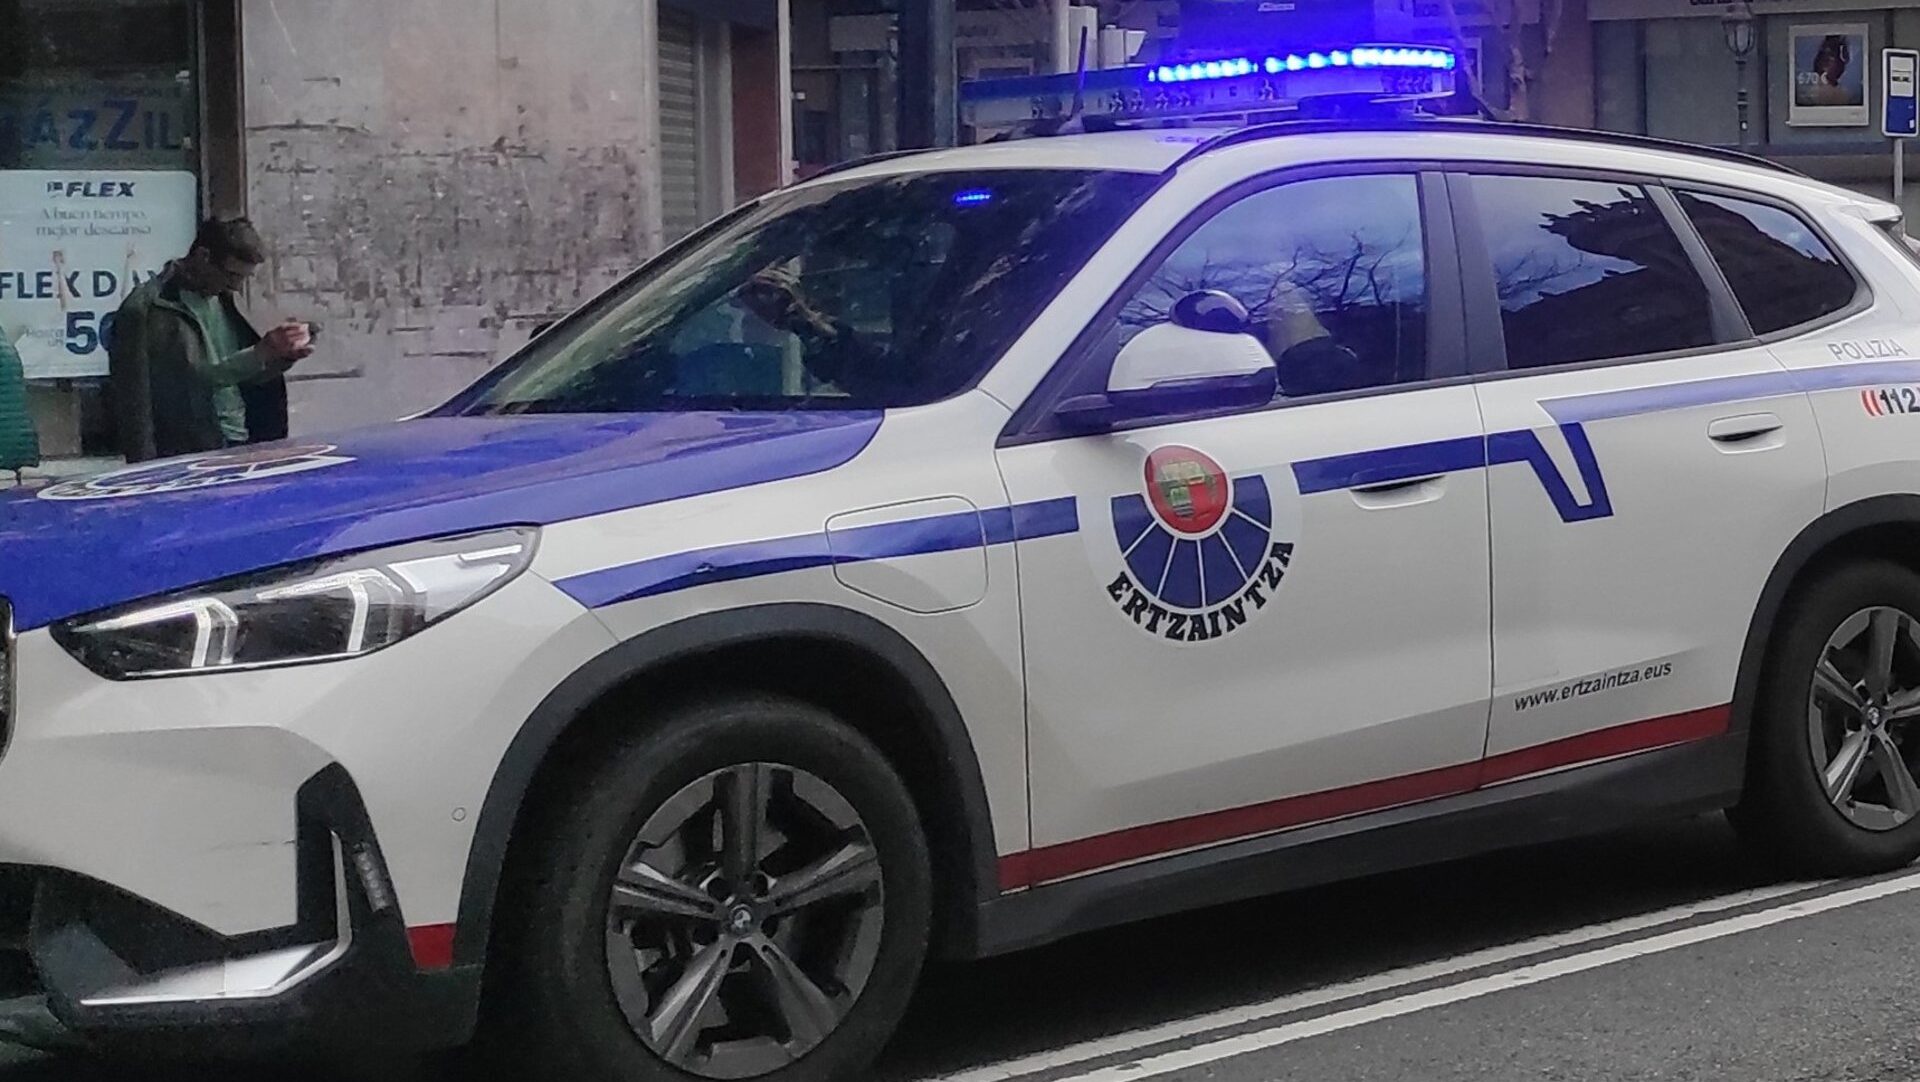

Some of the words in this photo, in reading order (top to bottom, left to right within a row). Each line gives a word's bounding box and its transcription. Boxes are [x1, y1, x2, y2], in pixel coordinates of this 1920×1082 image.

[66, 182, 135, 197] FLEX
[84, 222, 151, 235] descanso
[1827, 338, 1909, 361] POLIZIA
[1106, 542, 1294, 641] ERTZAINTZA
[1514, 662, 1672, 711] www.ertzaintza.eus
